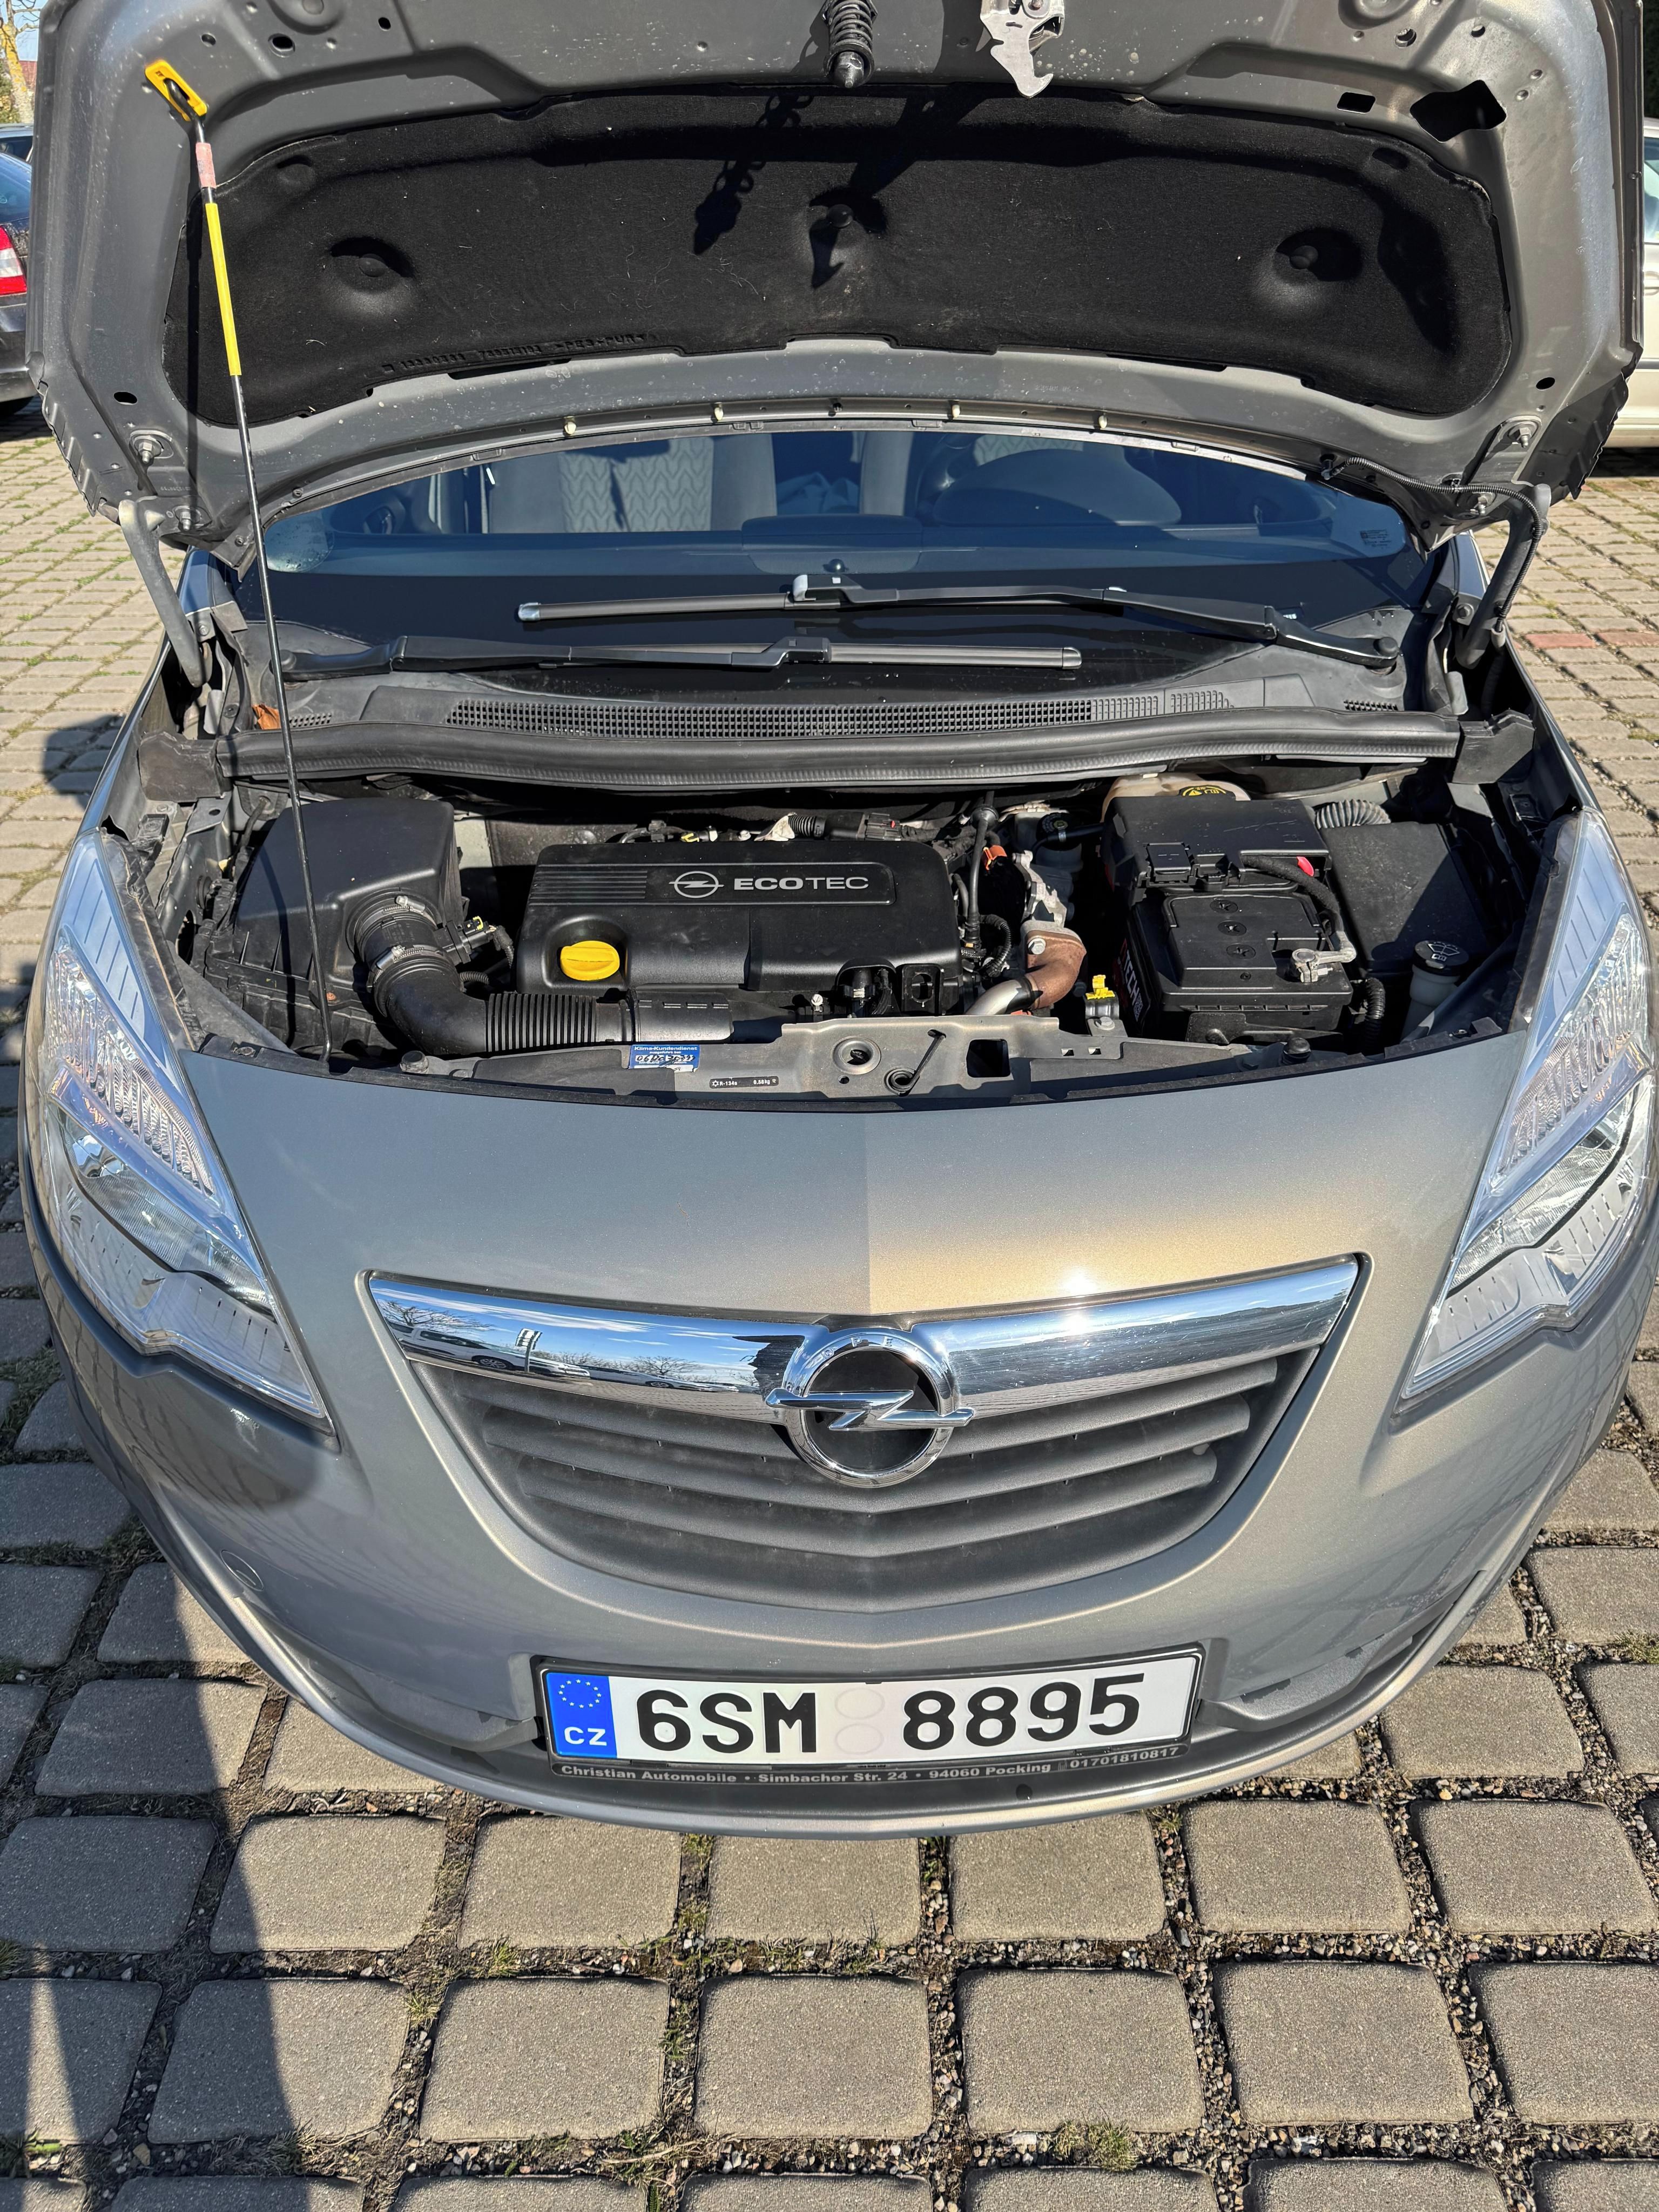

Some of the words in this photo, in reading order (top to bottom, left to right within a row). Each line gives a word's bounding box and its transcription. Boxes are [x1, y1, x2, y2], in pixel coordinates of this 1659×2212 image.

[734, 876, 868, 890] ECOTEC
[822, 1336, 919, 1360] OPE
[637, 1689, 817, 1754] 6SM
[903, 1673, 1144, 1750] 8895
[564, 1726, 607, 1746] CZ
[561, 1765, 636, 1779] Christian
[642, 1770, 737, 1783] Automobile
[758, 1773, 851, 1783] Simbacher
[853, 1771, 882, 1782] Str.
[887, 1771, 908, 1781] 24
[929, 1767, 980, 1779] 94060
[986, 1762, 1051, 1776] Pocking
[1069, 1746, 1179, 1769] 01701810817
